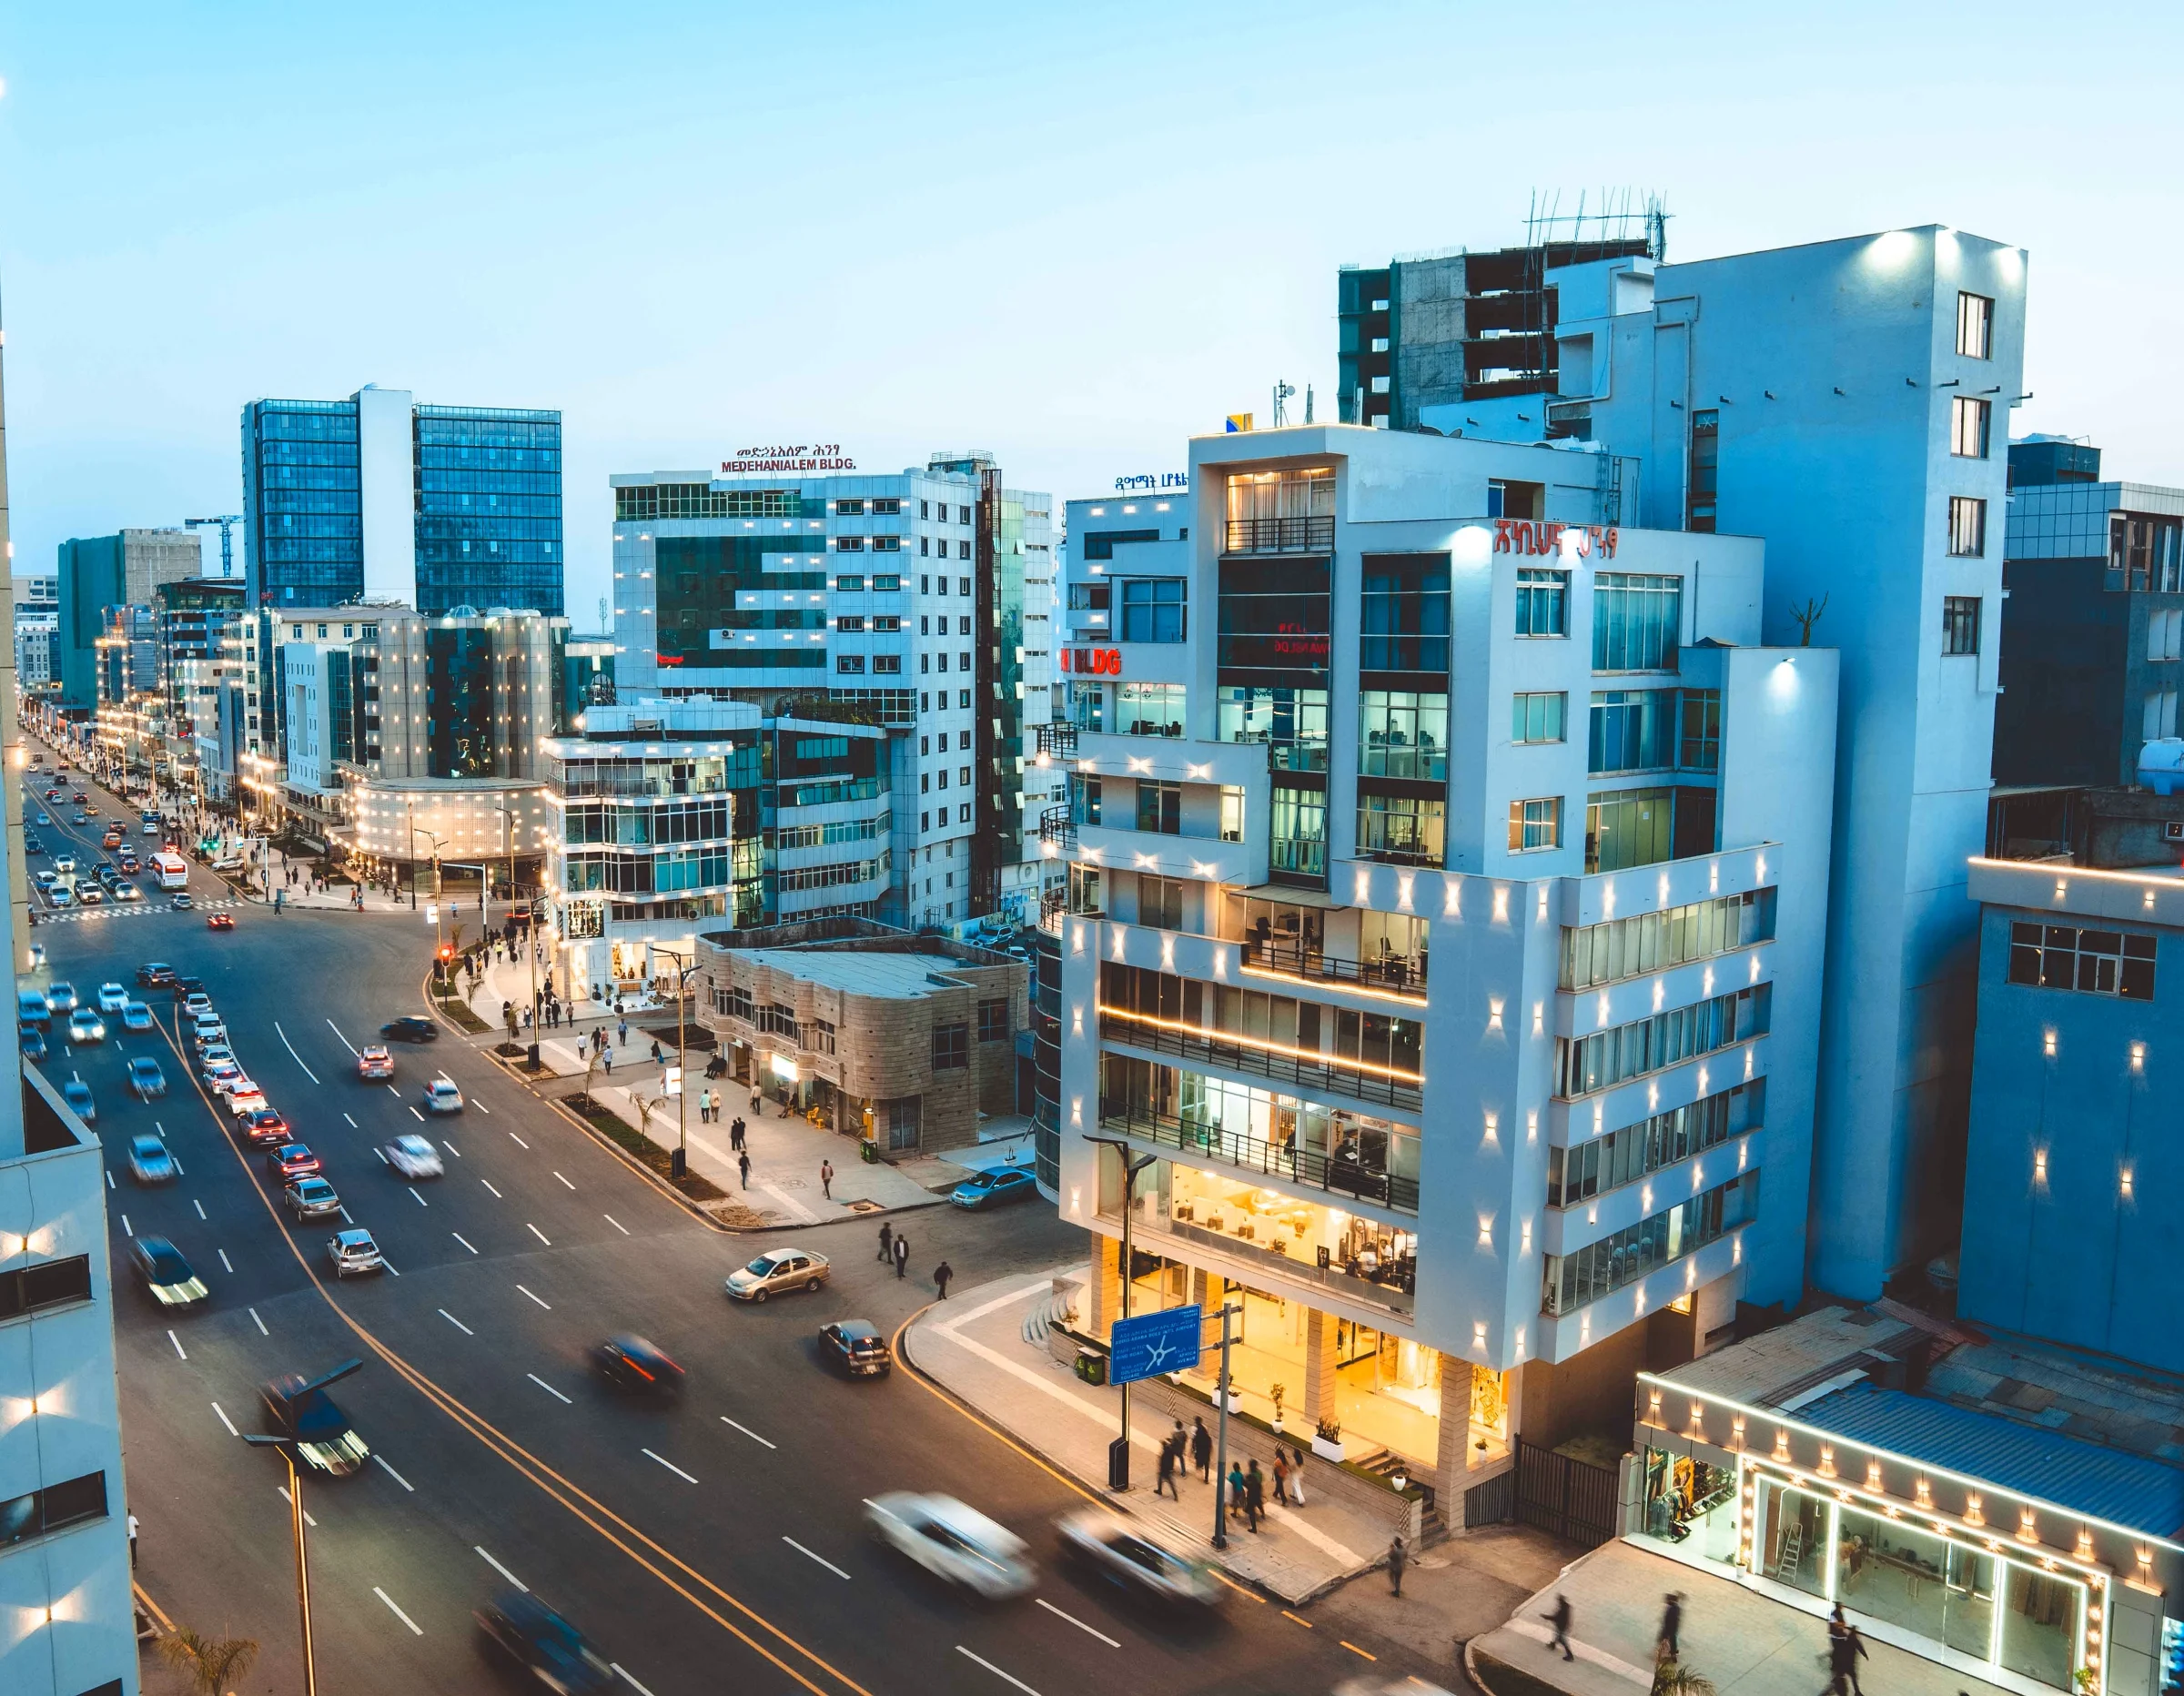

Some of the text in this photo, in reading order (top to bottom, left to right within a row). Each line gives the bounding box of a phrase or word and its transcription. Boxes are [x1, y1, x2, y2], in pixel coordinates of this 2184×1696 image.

[722, 458, 856, 472] MEDEHANIALEM BLDG.
[1075, 648, 1121, 675] BLDG
[1177, 1356, 1196, 1364] AVENUE
